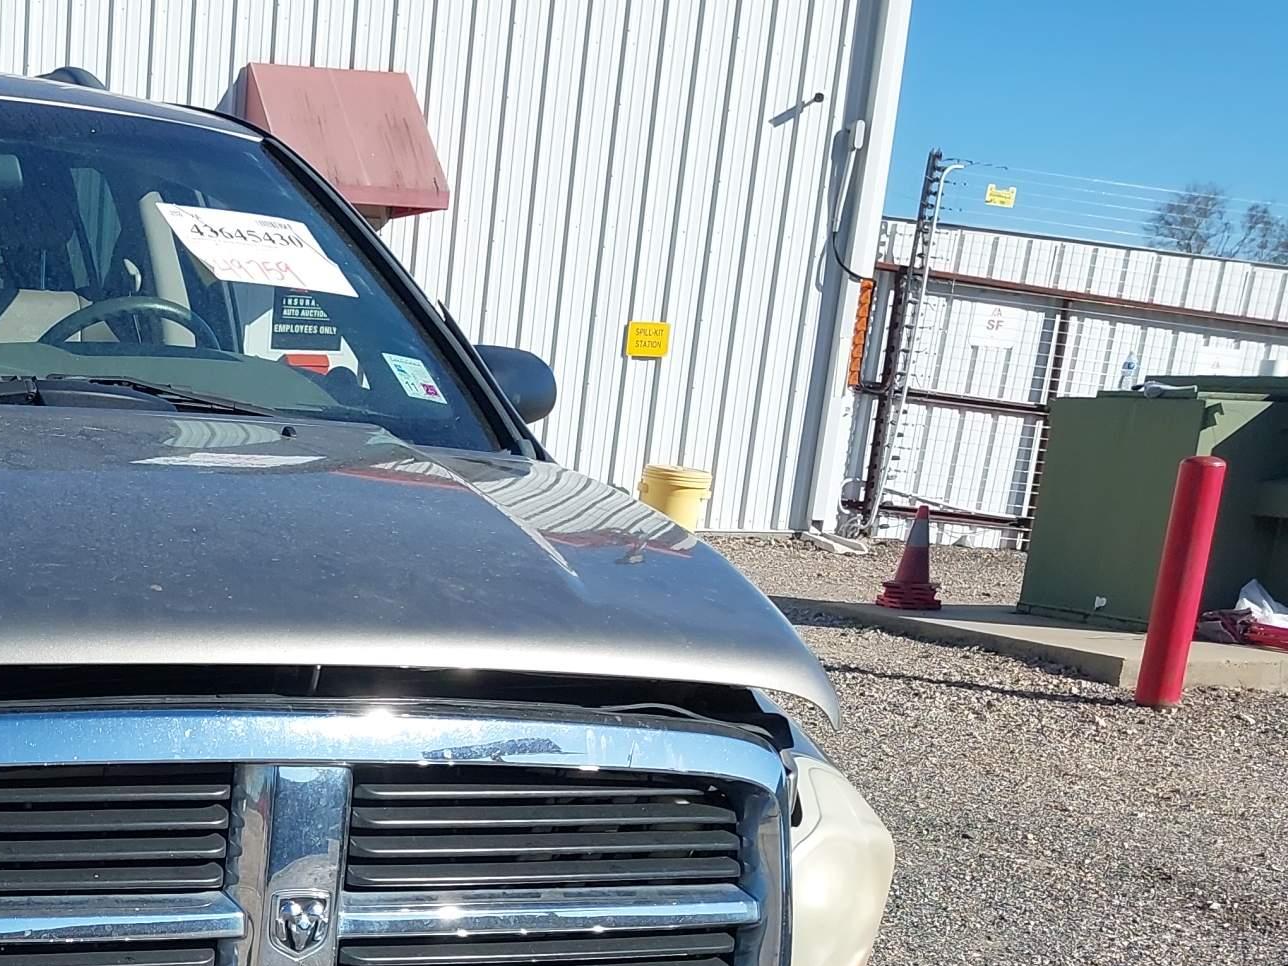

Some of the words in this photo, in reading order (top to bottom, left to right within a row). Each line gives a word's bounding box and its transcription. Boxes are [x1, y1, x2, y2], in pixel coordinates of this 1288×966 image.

[190, 223, 304, 248] 43645430
[282, 297, 319, 306] INSURA
[282, 308, 300, 316] AUTO
[273, 323, 318, 334] EMPLOYEES
[319, 325, 337, 335] ONLY
[986, 319, 1005, 331] SF
[634, 340, 662, 348] STATION
